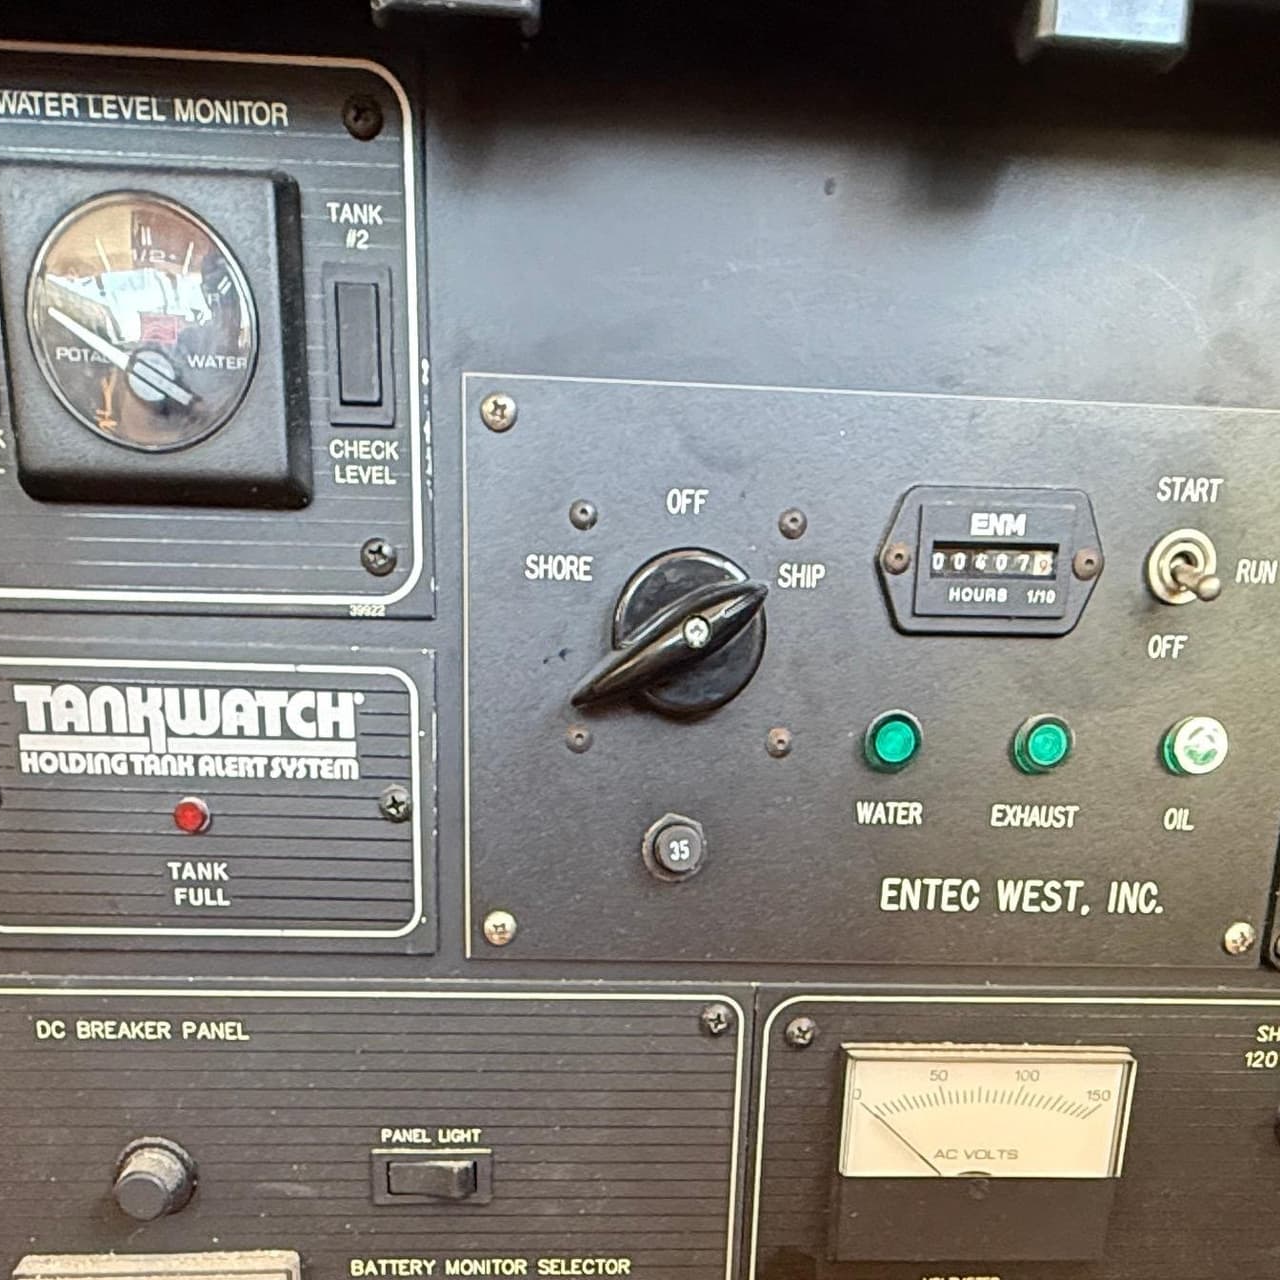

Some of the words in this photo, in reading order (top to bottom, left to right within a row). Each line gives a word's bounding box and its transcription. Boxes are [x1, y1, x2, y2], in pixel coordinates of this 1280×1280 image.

[88, 95, 164, 121] LEVEL
[175, 99, 289, 126] MONITOR
[326, 202, 383, 225] TANK
[345, 229, 369, 249] #2
[329, 439, 399, 460] CHECK
[334, 464, 396, 485] LEVEL
[666, 488, 709, 515] OFF
[1157, 477, 1223, 503] START
[970, 512, 1026, 537] ENM
[525, 554, 593, 582] SHORE
[778, 563, 825, 589] SHIP
[1236, 558, 1278, 585] RUN
[948, 587, 1007, 603] HOURS
[1026, 588, 1056, 604] 1/10
[1148, 634, 1187, 659] OFF
[13, 684, 358, 752] TANKWATCH
[20, 751, 128, 776] HOLDING
[129, 754, 194, 776] TANK
[198, 756, 267, 779] ALERT
[269, 757, 359, 780] SYSTEM
[857, 801, 923, 825] WATER
[991, 805, 1079, 829] EXHAUST
[1163, 808, 1194, 831] OIL
[670, 840, 689, 861] 35
[168, 862, 229, 882] TANK
[174, 886, 230, 907] FULL
[879, 877, 980, 913] ENTEC
[997, 880, 1090, 915] WEST,
[1107, 881, 1164, 914] INC.
[36, 1021, 65, 1039] DC
[77, 1021, 171, 1040] BREAKER
[183, 1021, 250, 1041] PANEL
[381, 1129, 431, 1143] PANEL
[439, 1129, 481, 1143] LIGHT
[934, 1150, 959, 1160] AC
[964, 1150, 1018, 1160] VOLTS
[350, 1259, 436, 1276] BATTERY
[445, 1259, 527, 1275] MONITOR
[538, 1258, 631, 1275] SELECTOR
